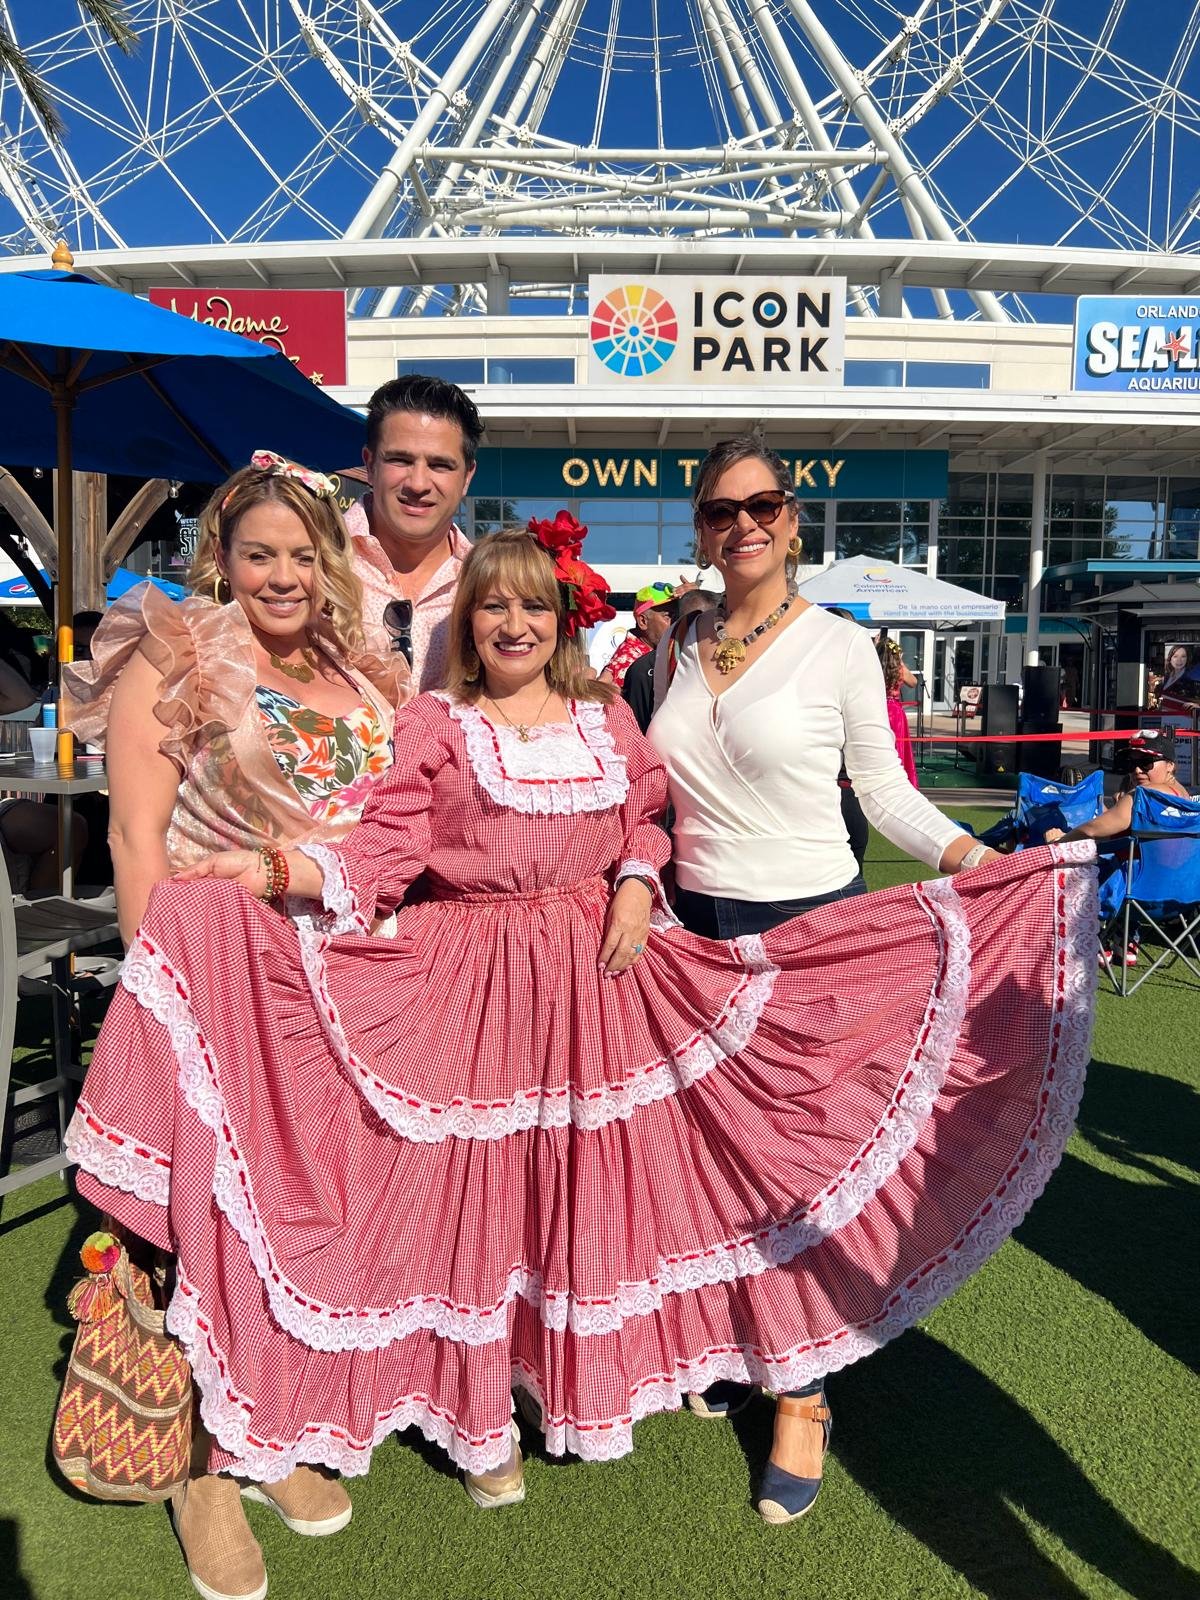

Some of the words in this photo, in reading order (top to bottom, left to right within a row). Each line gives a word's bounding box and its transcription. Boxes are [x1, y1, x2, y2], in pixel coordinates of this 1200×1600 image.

[694, 291, 831, 329] ICON
[1136, 305, 1200, 318] ORLAND
[693, 336, 830, 372] PARK
[1087, 321, 1169, 375] SEA
[1178, 325, 1200, 370] L
[1127, 377, 1200, 391] AQUARIU
[562, 457, 658, 487] OWN
[677, 458, 700, 487] T
[784, 459, 846, 488] KY
